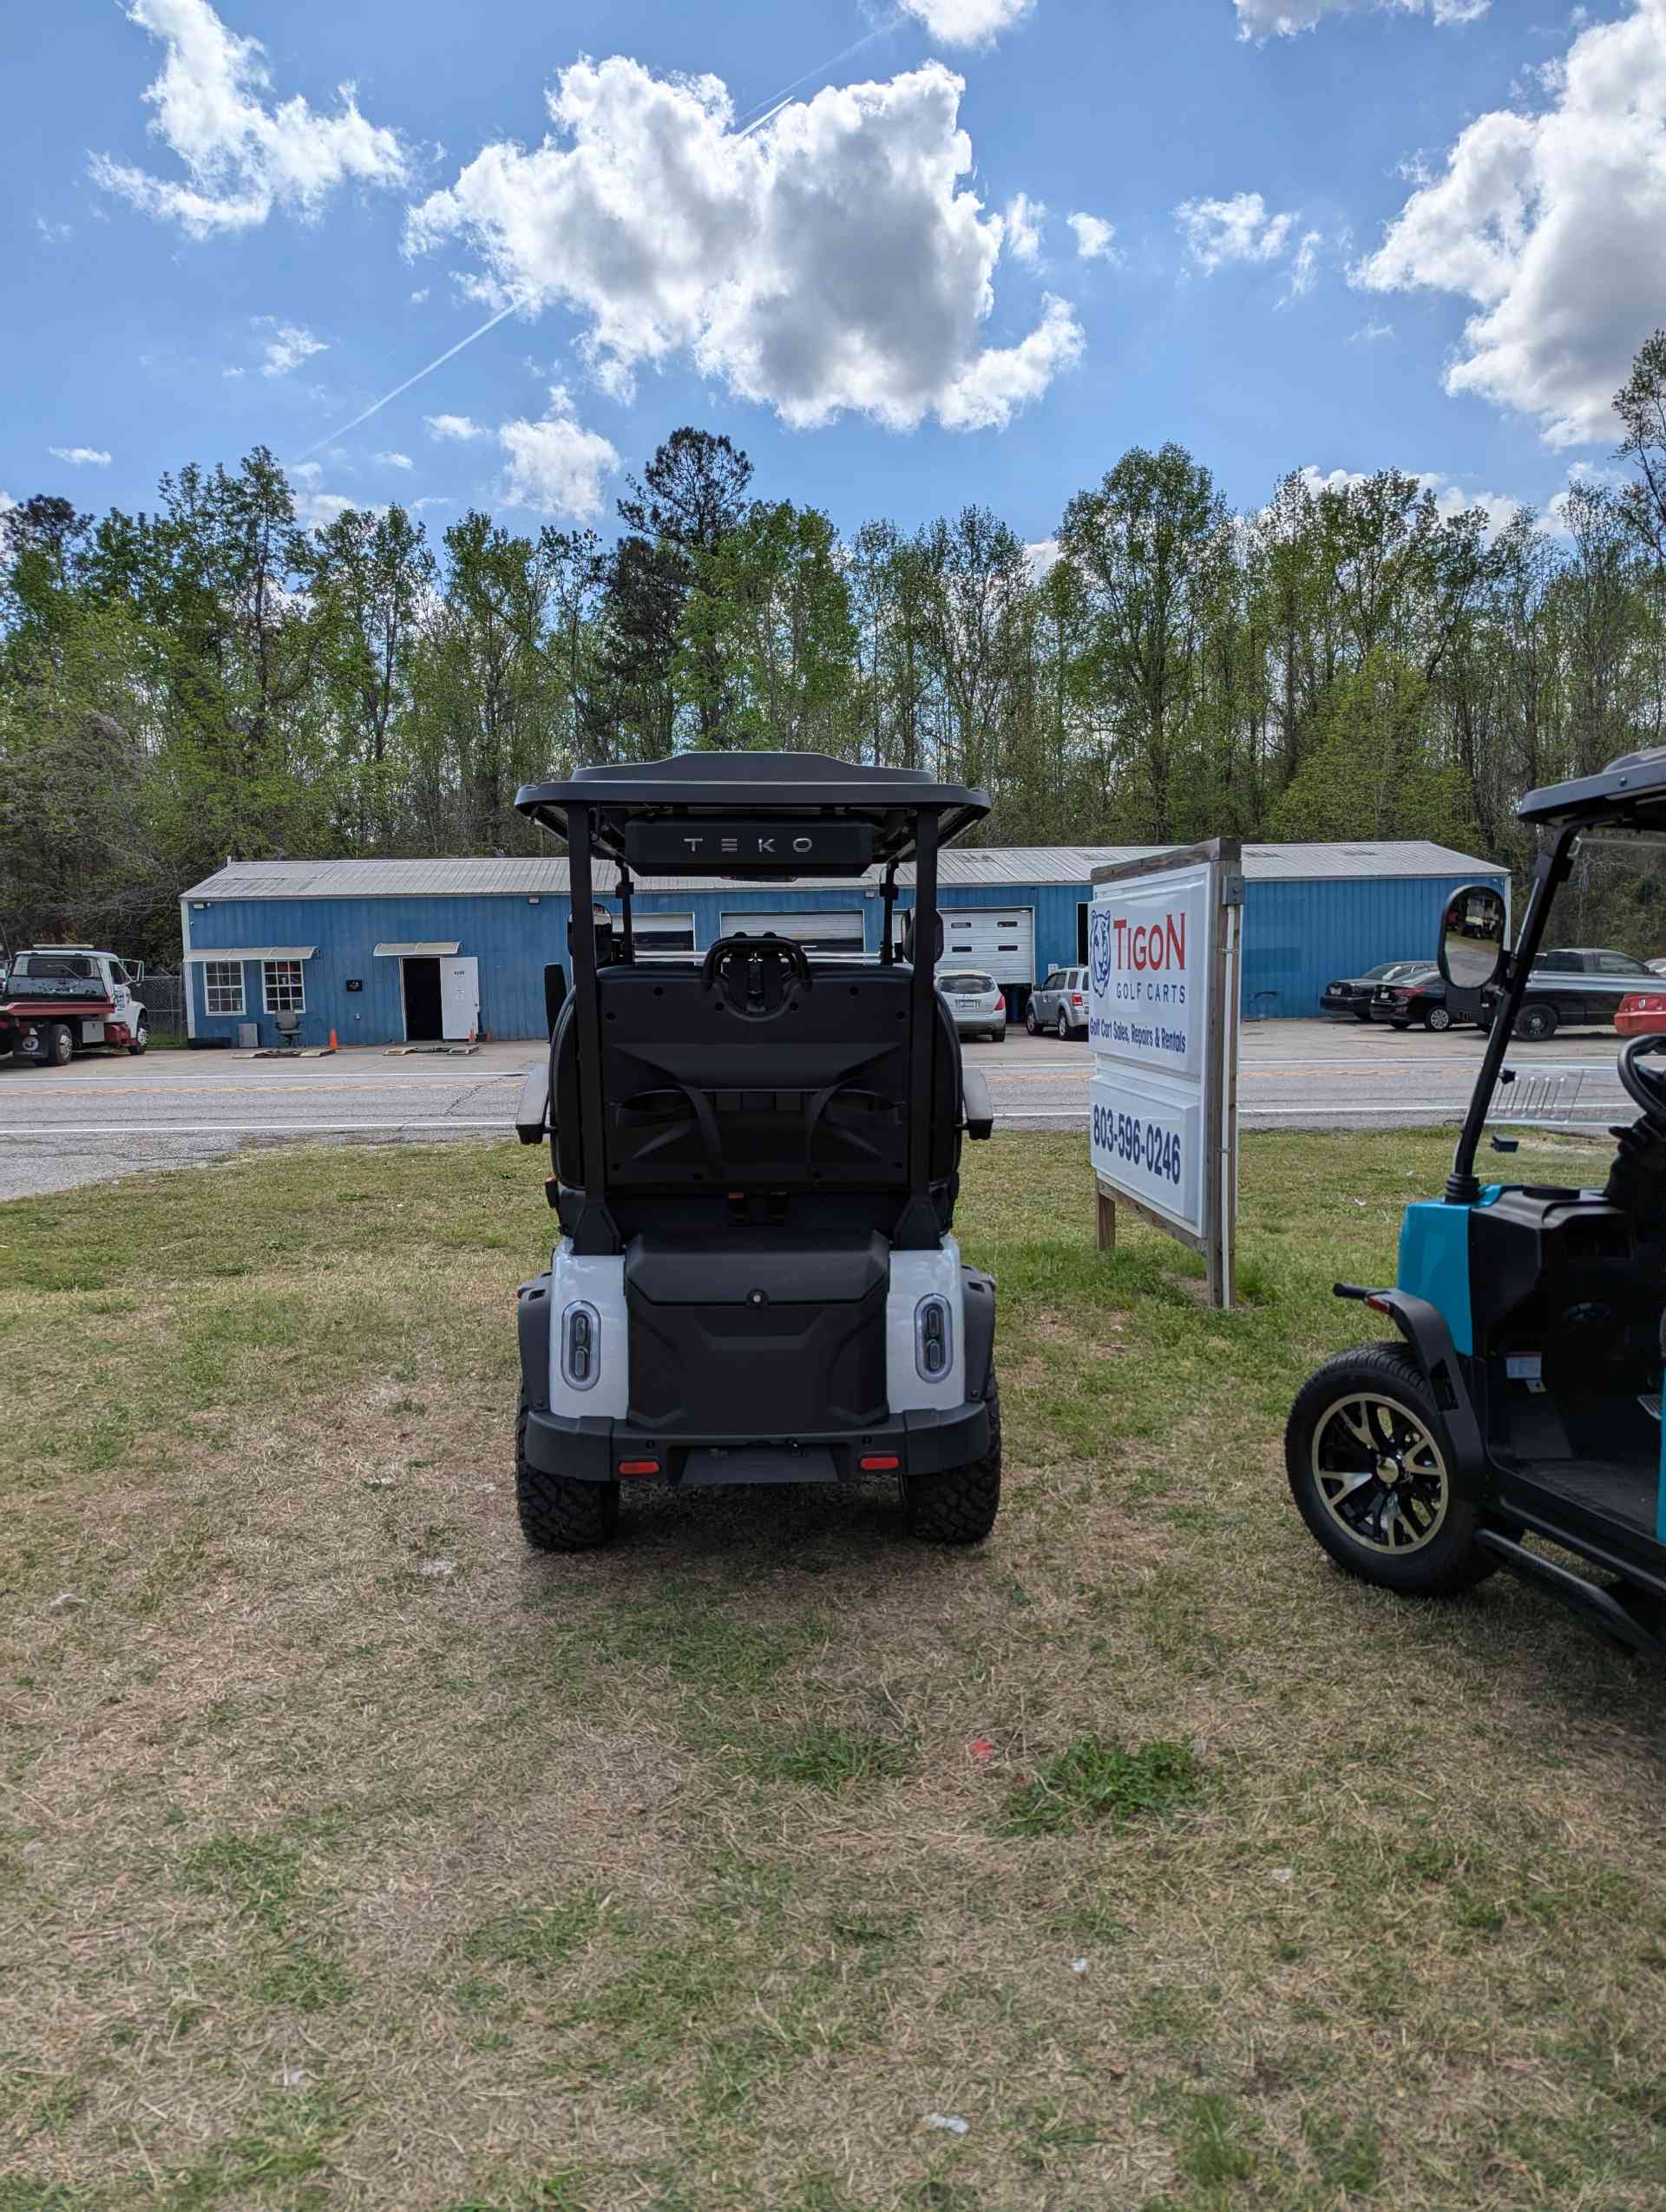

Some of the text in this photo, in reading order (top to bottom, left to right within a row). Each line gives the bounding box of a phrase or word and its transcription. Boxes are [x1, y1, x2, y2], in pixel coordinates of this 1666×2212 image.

[683, 837, 813, 853] TEKO
[1113, 912, 1186, 971] TIGON
[1116, 982, 1185, 1004] GOLF CARTS
[1090, 1018, 1186, 1054] Golf Cart Sales, Repairs & Rentals
[1093, 1104, 1181, 1185] 803-596-0246
